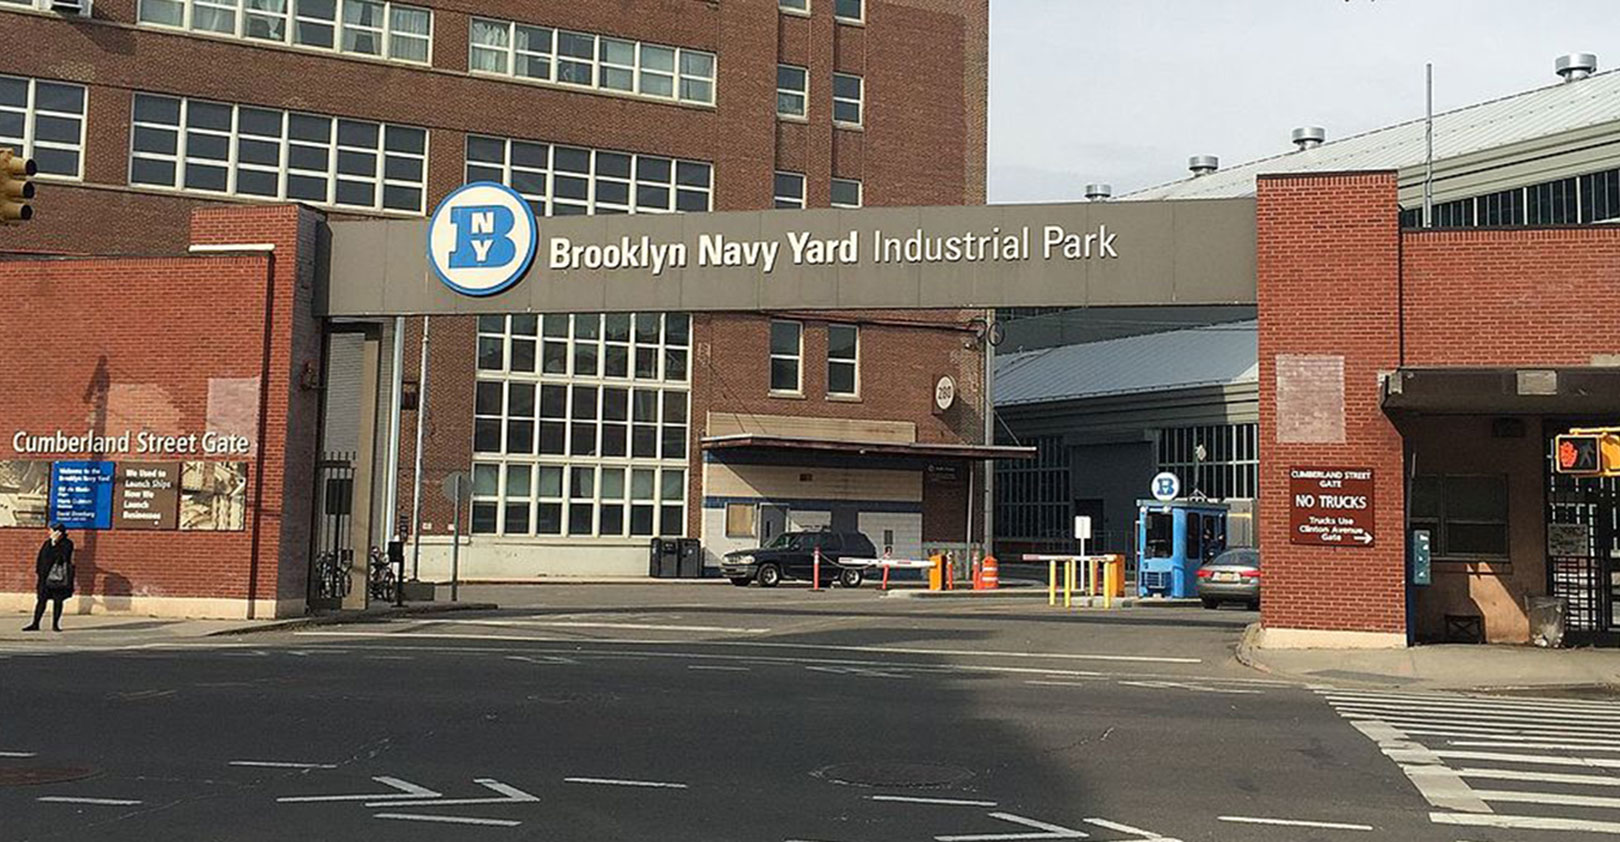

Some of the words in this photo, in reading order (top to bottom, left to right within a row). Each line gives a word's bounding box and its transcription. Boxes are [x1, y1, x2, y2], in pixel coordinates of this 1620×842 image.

[549, 236, 688, 275] Brooklyn
[698, 234, 779, 273] Navy
[787, 231, 858, 264] Yard
[874, 226, 1030, 263] Industrial
[1043, 225, 1119, 259] Park
[13, 429, 130, 454] Cumberland
[136, 431, 196, 454] Street
[201, 432, 250, 454] Gate
[126, 469, 138, 478] We
[139, 469, 157, 478] Used
[158, 470, 167, 478] to
[1291, 470, 1343, 479] CUMBERLAND
[1344, 471, 1372, 479] STREET
[125, 479, 150, 488] Launch
[152, 479, 171, 490] Ships
[1319, 480, 1342, 488] GATE
[124, 490, 141, 498] Now
[142, 490, 154, 498] We
[124, 500, 149, 509] Launch
[1295, 494, 1315, 508] NO
[1319, 495, 1367, 509] TRUCKS
[123, 510, 161, 519] Businesses
[1309, 516, 1335, 525] Trucks
[1338, 517, 1354, 525] Use
[1299, 525, 1330, 533] Clinton
[1332, 526, 1363, 534] Avenue
[1321, 533, 1342, 541] Gate
